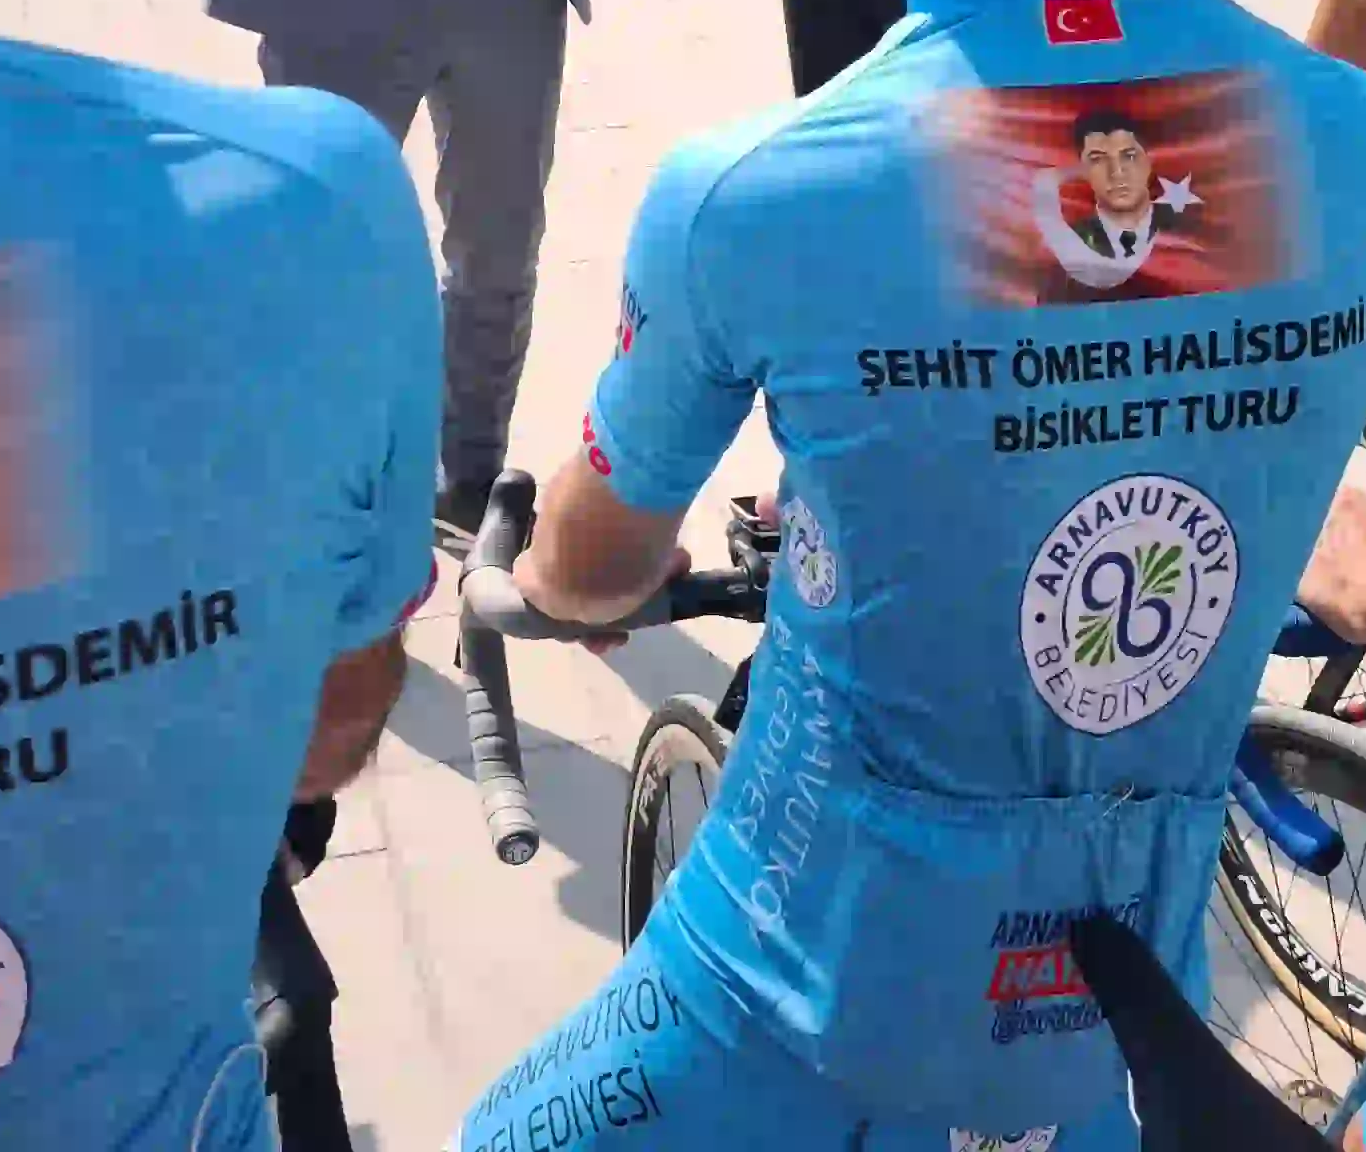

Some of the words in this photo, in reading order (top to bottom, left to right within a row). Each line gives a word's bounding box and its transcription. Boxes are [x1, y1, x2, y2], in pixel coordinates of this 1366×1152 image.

[857, 340, 997, 396] ŞEHİT
[1011, 339, 1132, 388] ÖMER
[993, 398, 1169, 452] BİSİKLET
[1177, 386, 1300, 436] TURU
[1035, 486, 1229, 597] ARNAVUTKÖY
